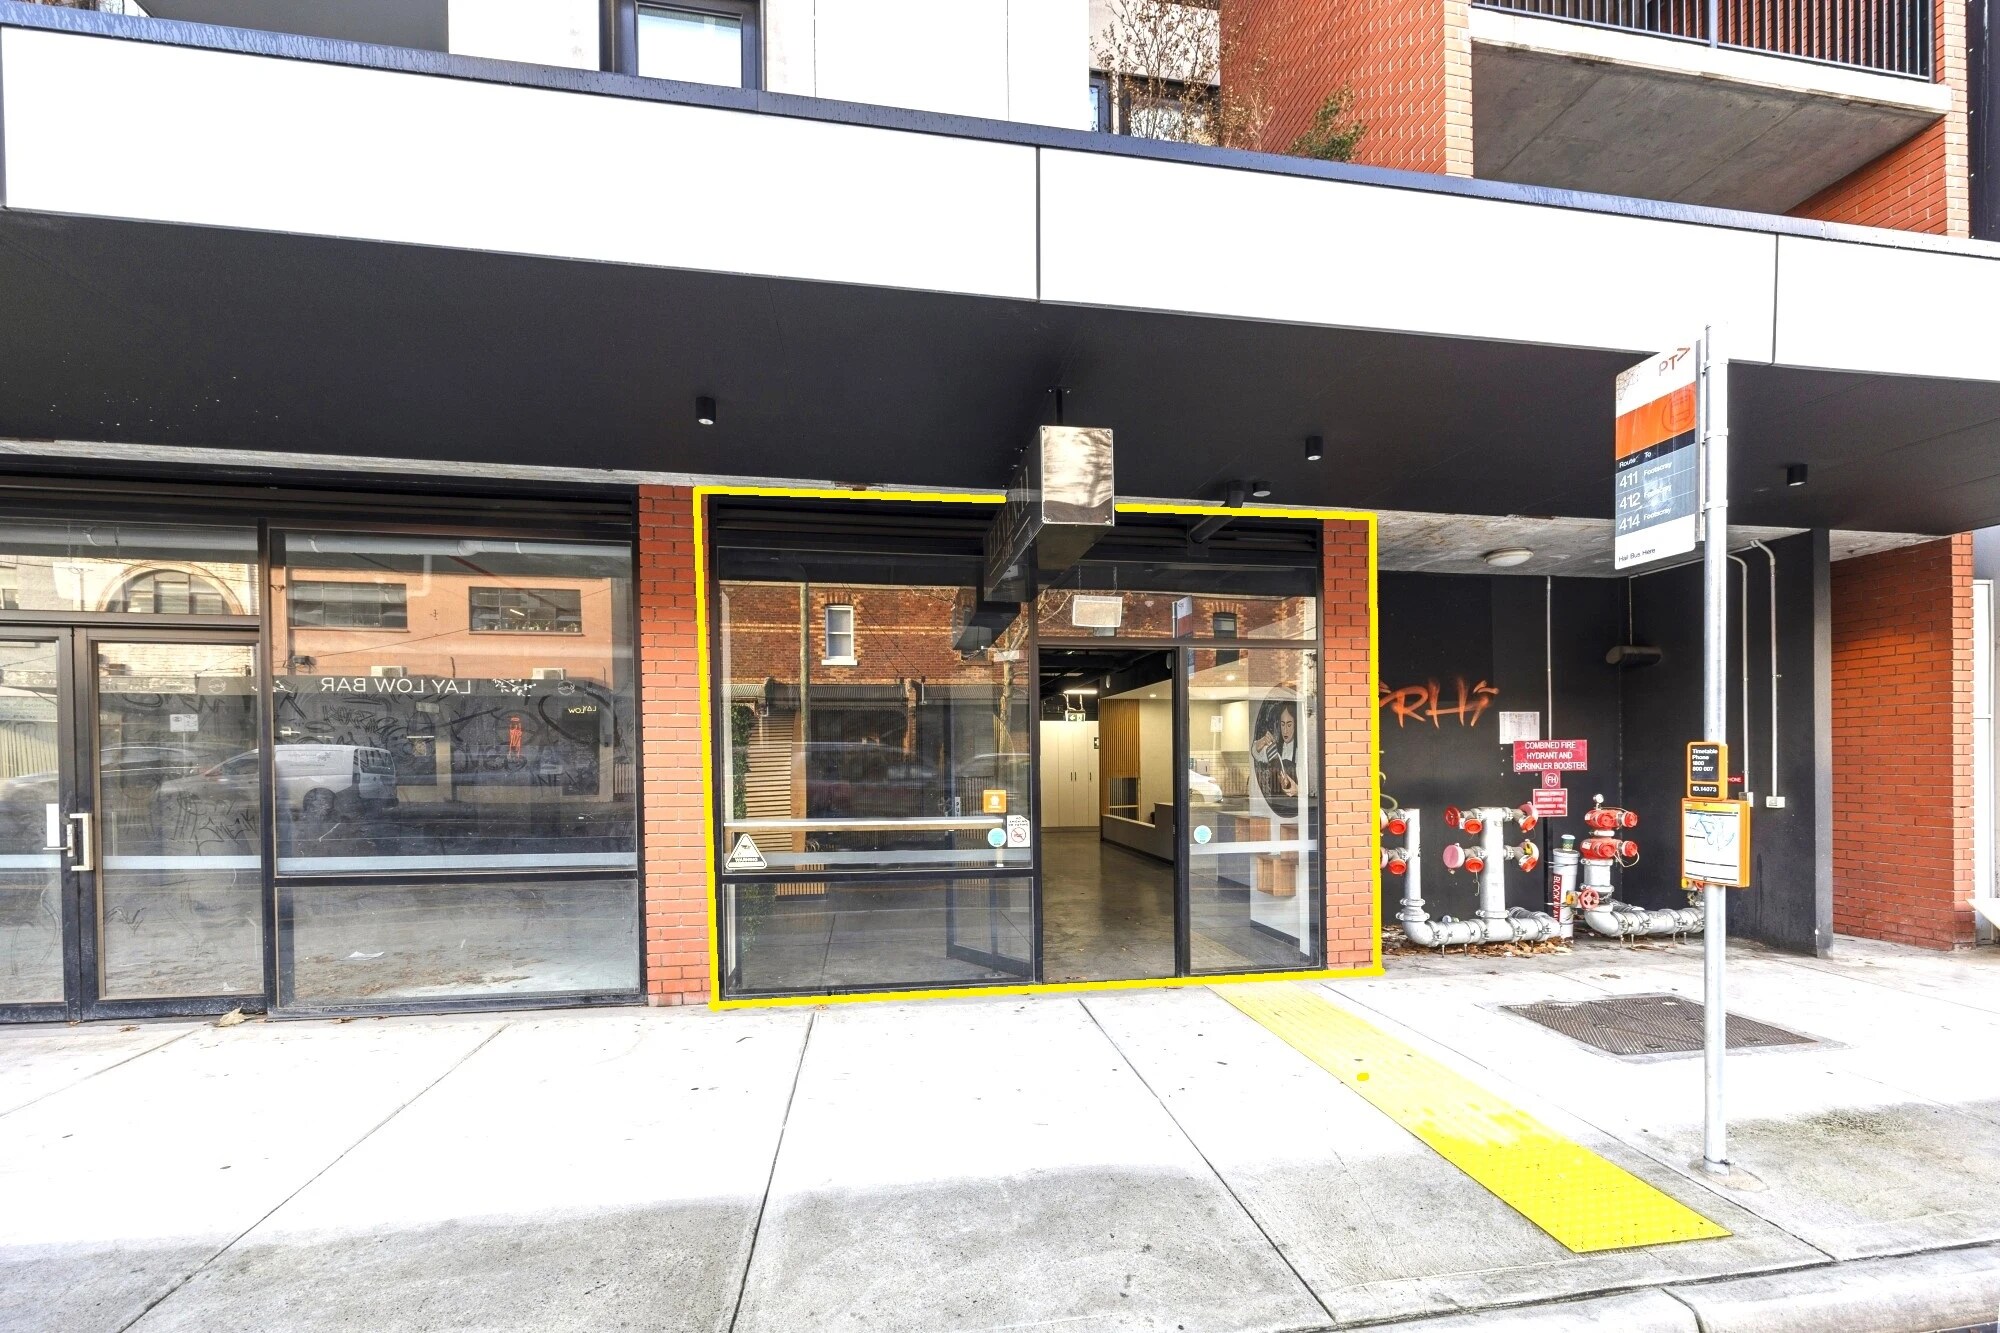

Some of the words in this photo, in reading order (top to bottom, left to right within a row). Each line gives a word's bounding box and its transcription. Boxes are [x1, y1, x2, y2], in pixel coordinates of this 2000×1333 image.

[1619, 457, 1636, 468] Route
[1619, 470, 1638, 487] 411
[1643, 461, 1672, 476] Footscray
[1619, 492, 1641, 509] 412
[1618, 513, 1640, 530] 414
[1643, 507, 1671, 520] Footscray
[1524, 741, 1560, 749] COMBINED
[1560, 741, 1576, 749] FIRE
[1558, 751, 1573, 759] AND
[1515, 762, 1553, 770] SPRINKLER
[1553, 761, 1586, 769] BOOSTER
[1547, 775, 1557, 784] FH
[1553, 876, 1561, 900] BLOCK
